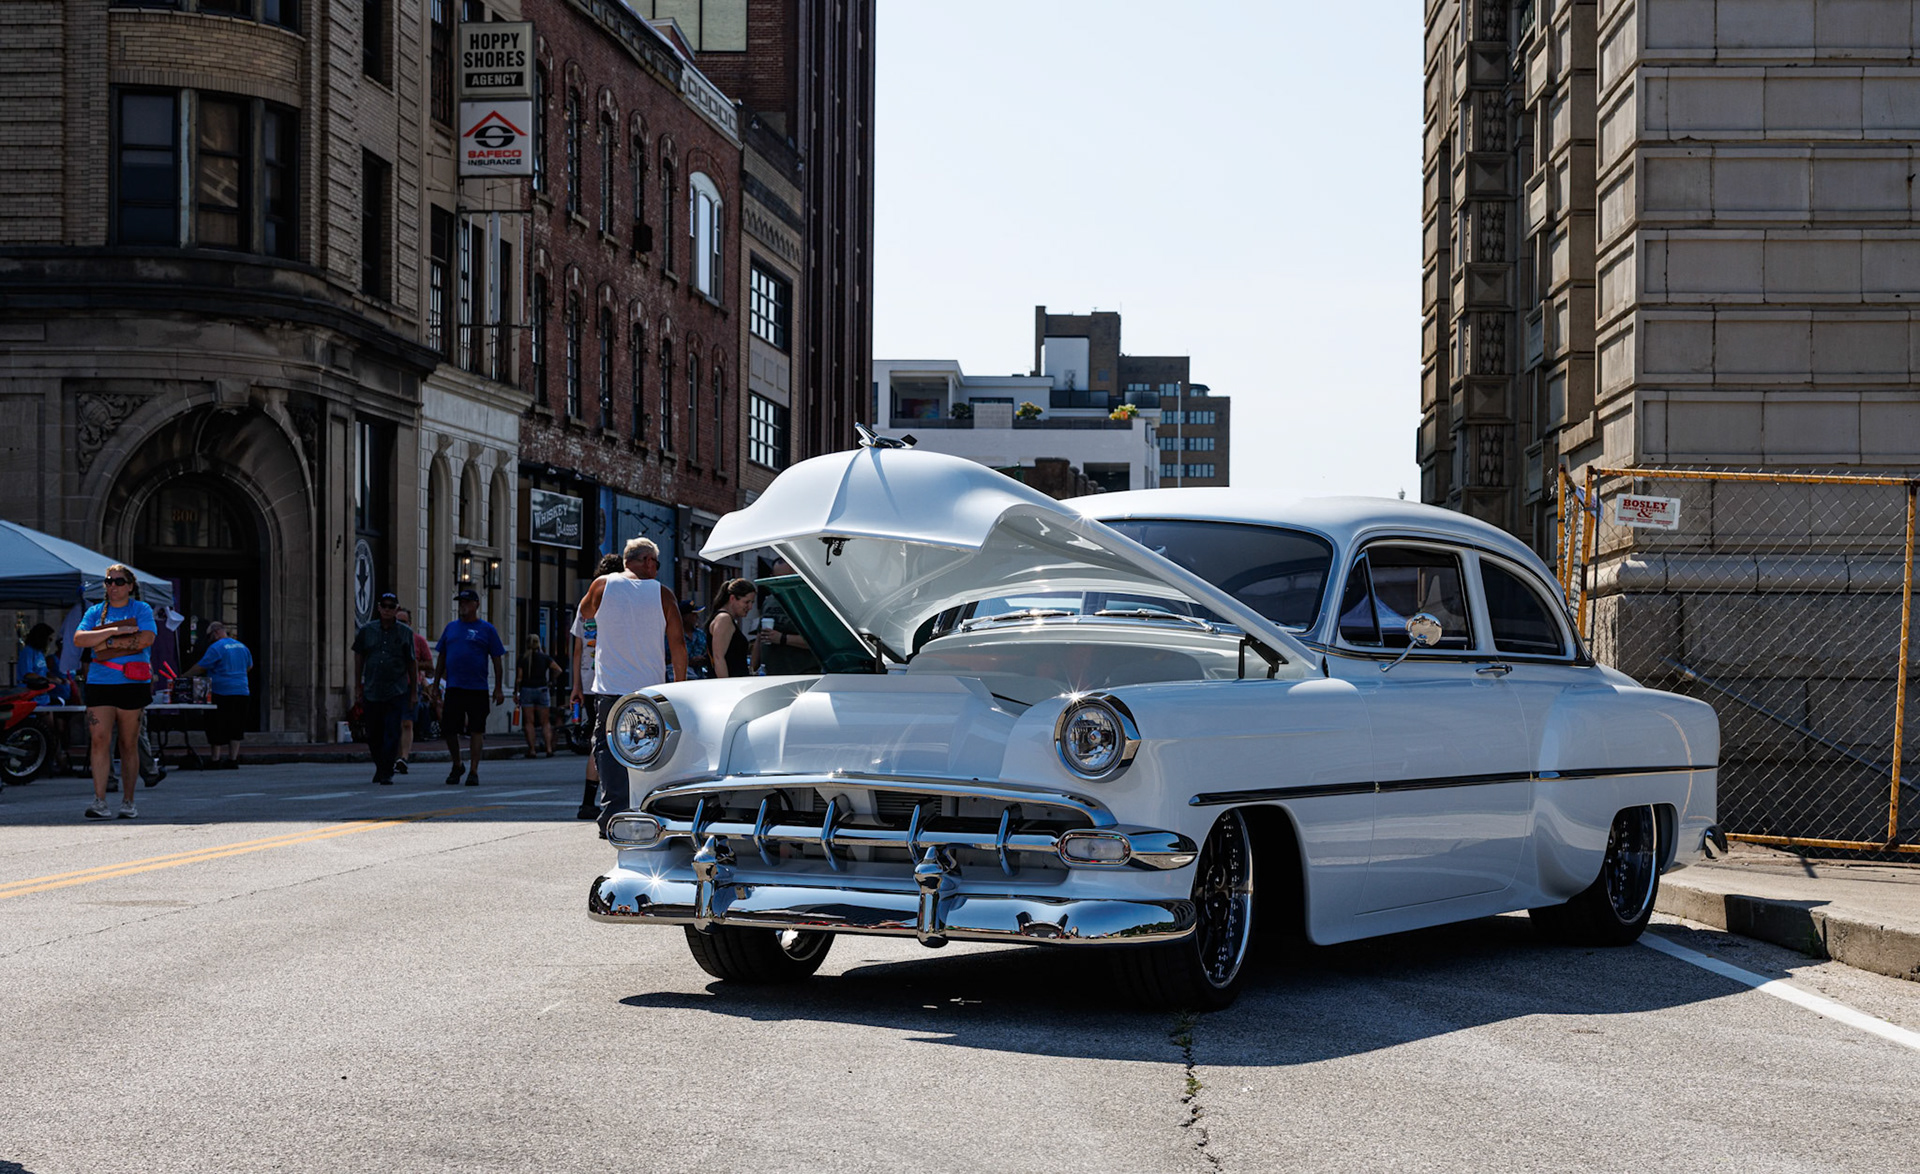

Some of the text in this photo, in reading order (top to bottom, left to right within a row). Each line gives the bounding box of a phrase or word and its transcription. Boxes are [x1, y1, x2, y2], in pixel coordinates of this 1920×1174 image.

[470, 33, 519, 50] HOPPY
[464, 51, 525, 68] SHORES
[472, 74, 517, 86] AGENCY
[467, 149, 522, 158] SAFECO
[467, 158, 522, 166] INSURANCE
[1623, 499, 1668, 510] BOSLEY
[172, 509, 198, 521] 800
[534, 504, 568, 529] WHISKEY
[556, 517, 578, 537] GLASSES
